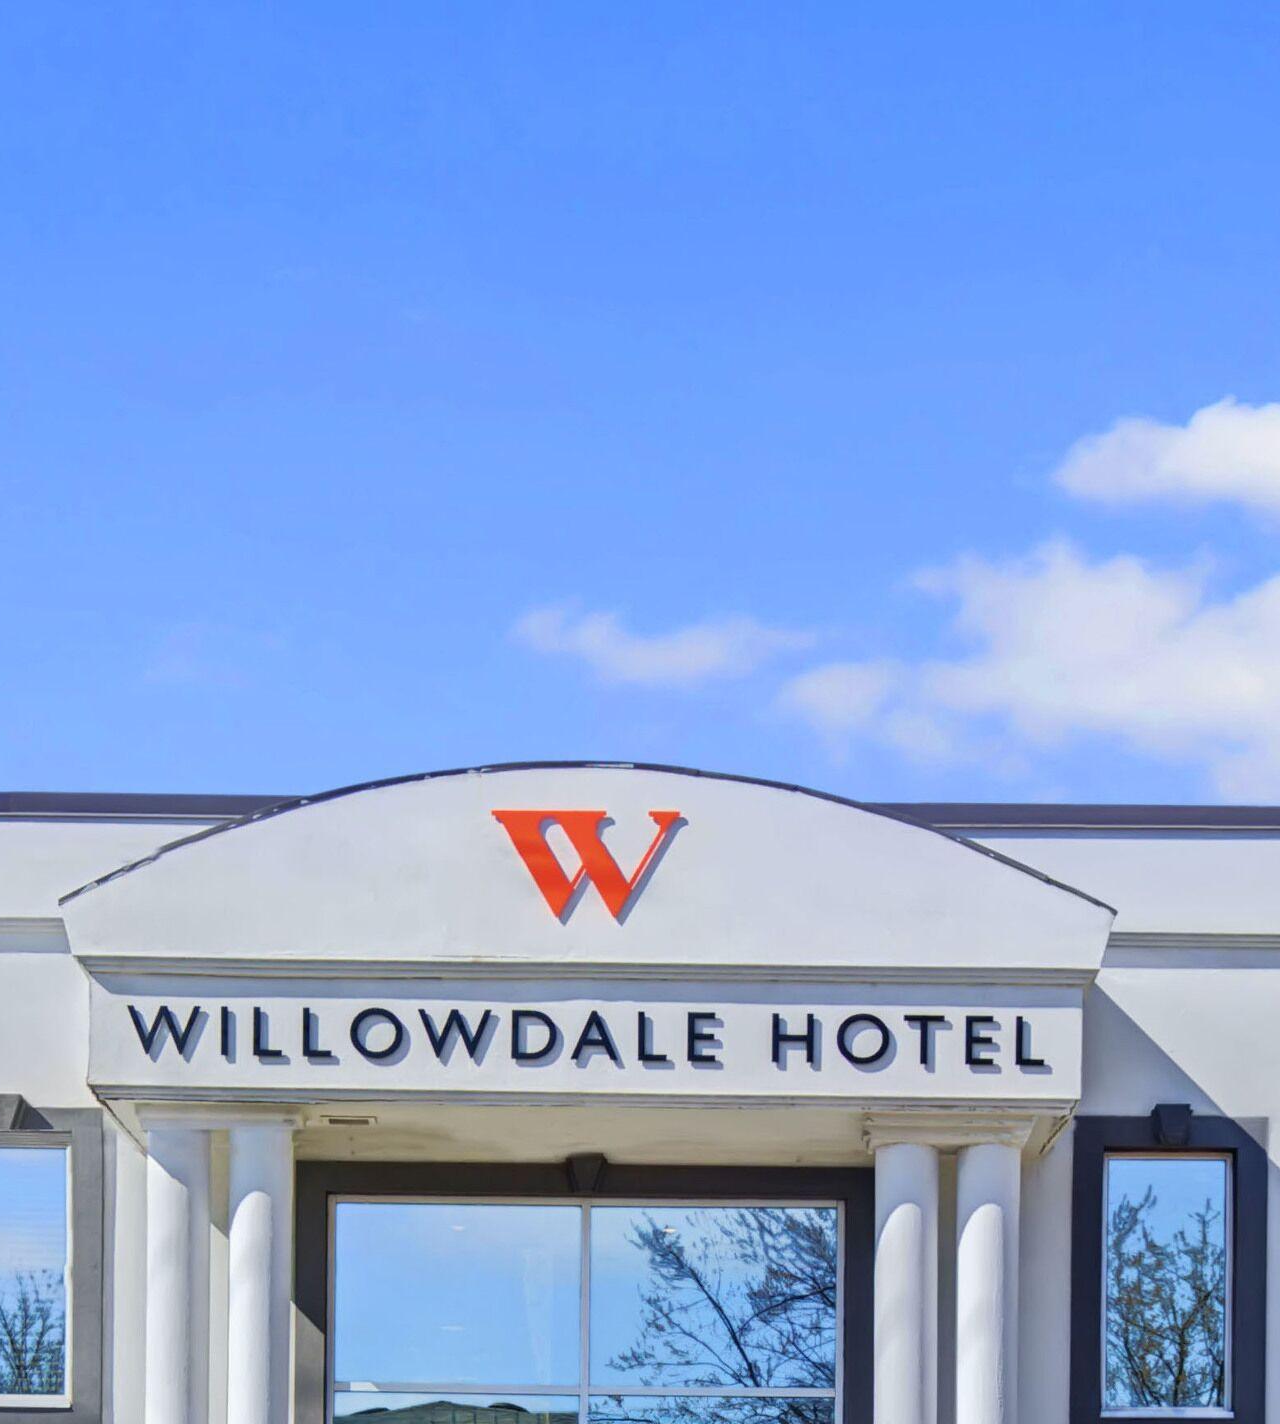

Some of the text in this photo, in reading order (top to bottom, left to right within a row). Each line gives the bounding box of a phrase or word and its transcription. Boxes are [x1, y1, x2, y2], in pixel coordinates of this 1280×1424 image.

[491, 810, 681, 919] W
[127, 1004, 1045, 1066] WILLOWDALE HOTEL
